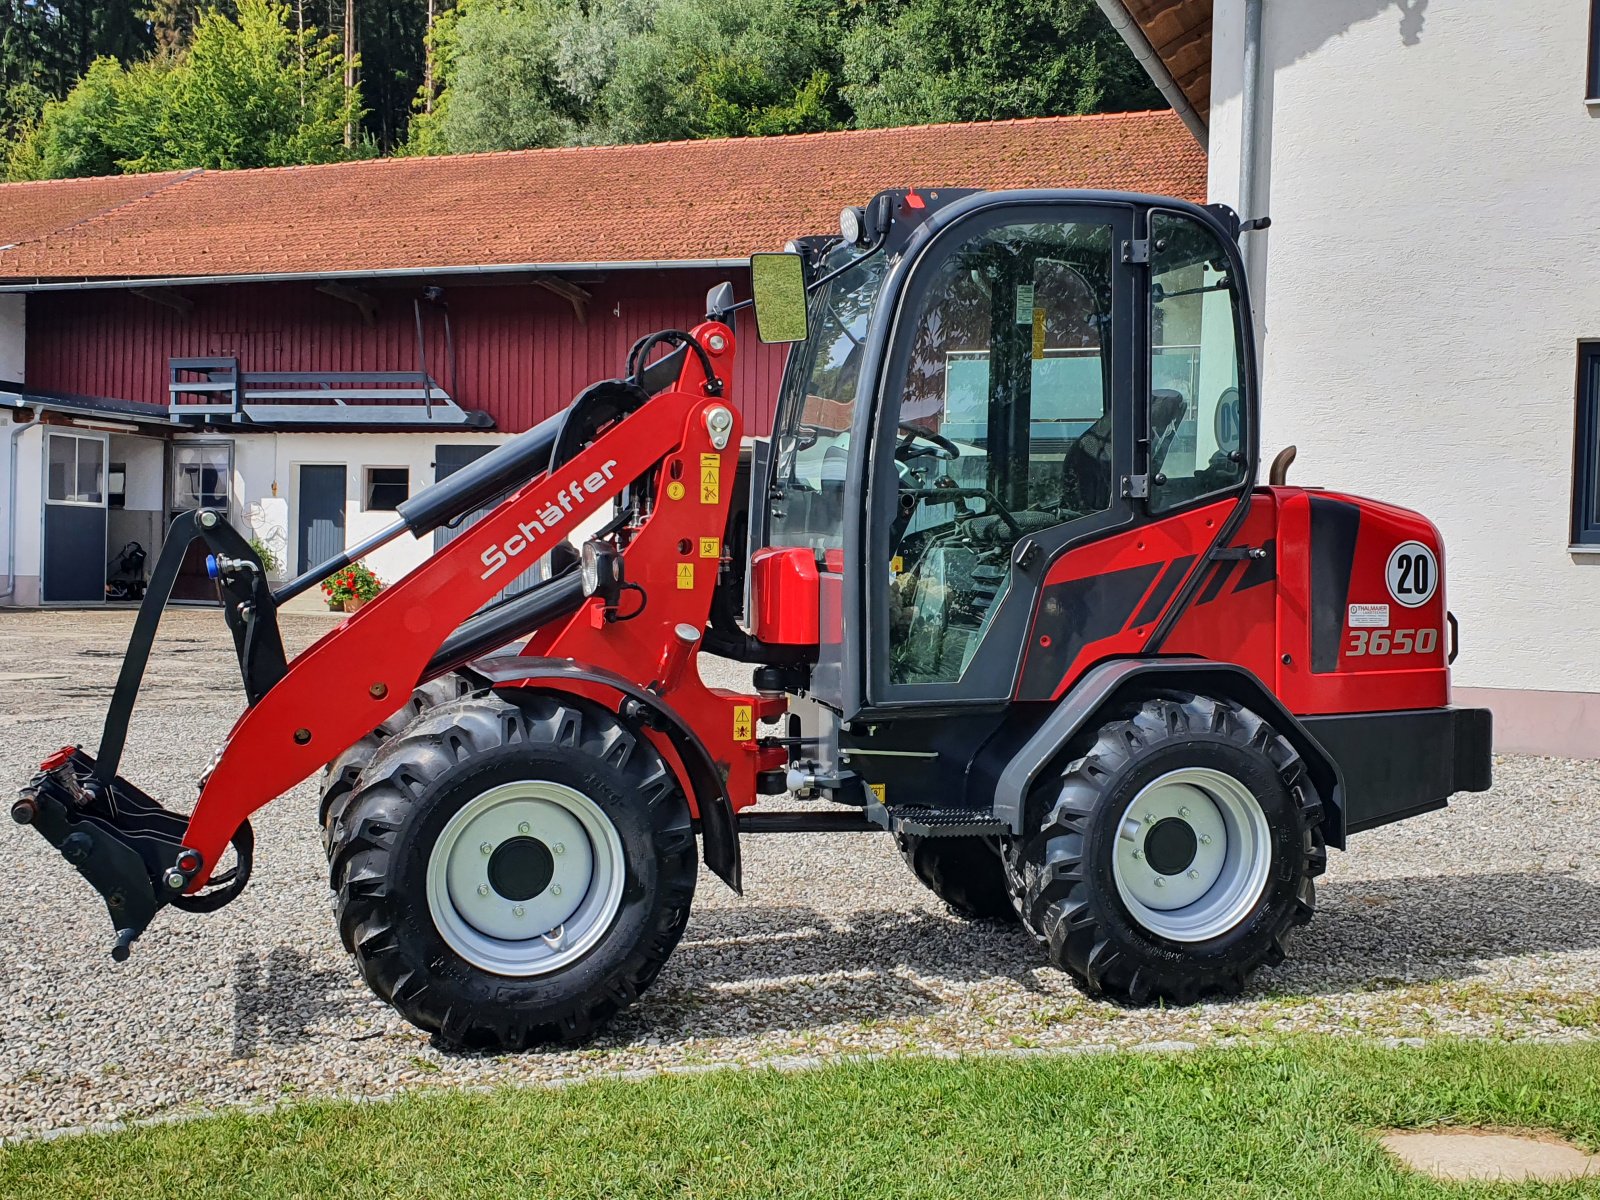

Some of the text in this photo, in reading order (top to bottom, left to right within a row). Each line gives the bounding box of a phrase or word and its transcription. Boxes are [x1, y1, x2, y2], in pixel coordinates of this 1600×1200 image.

[480, 459, 617, 581] Schäffer
[1397, 554, 1428, 594] 20
[1345, 628, 1438, 657] 3650
